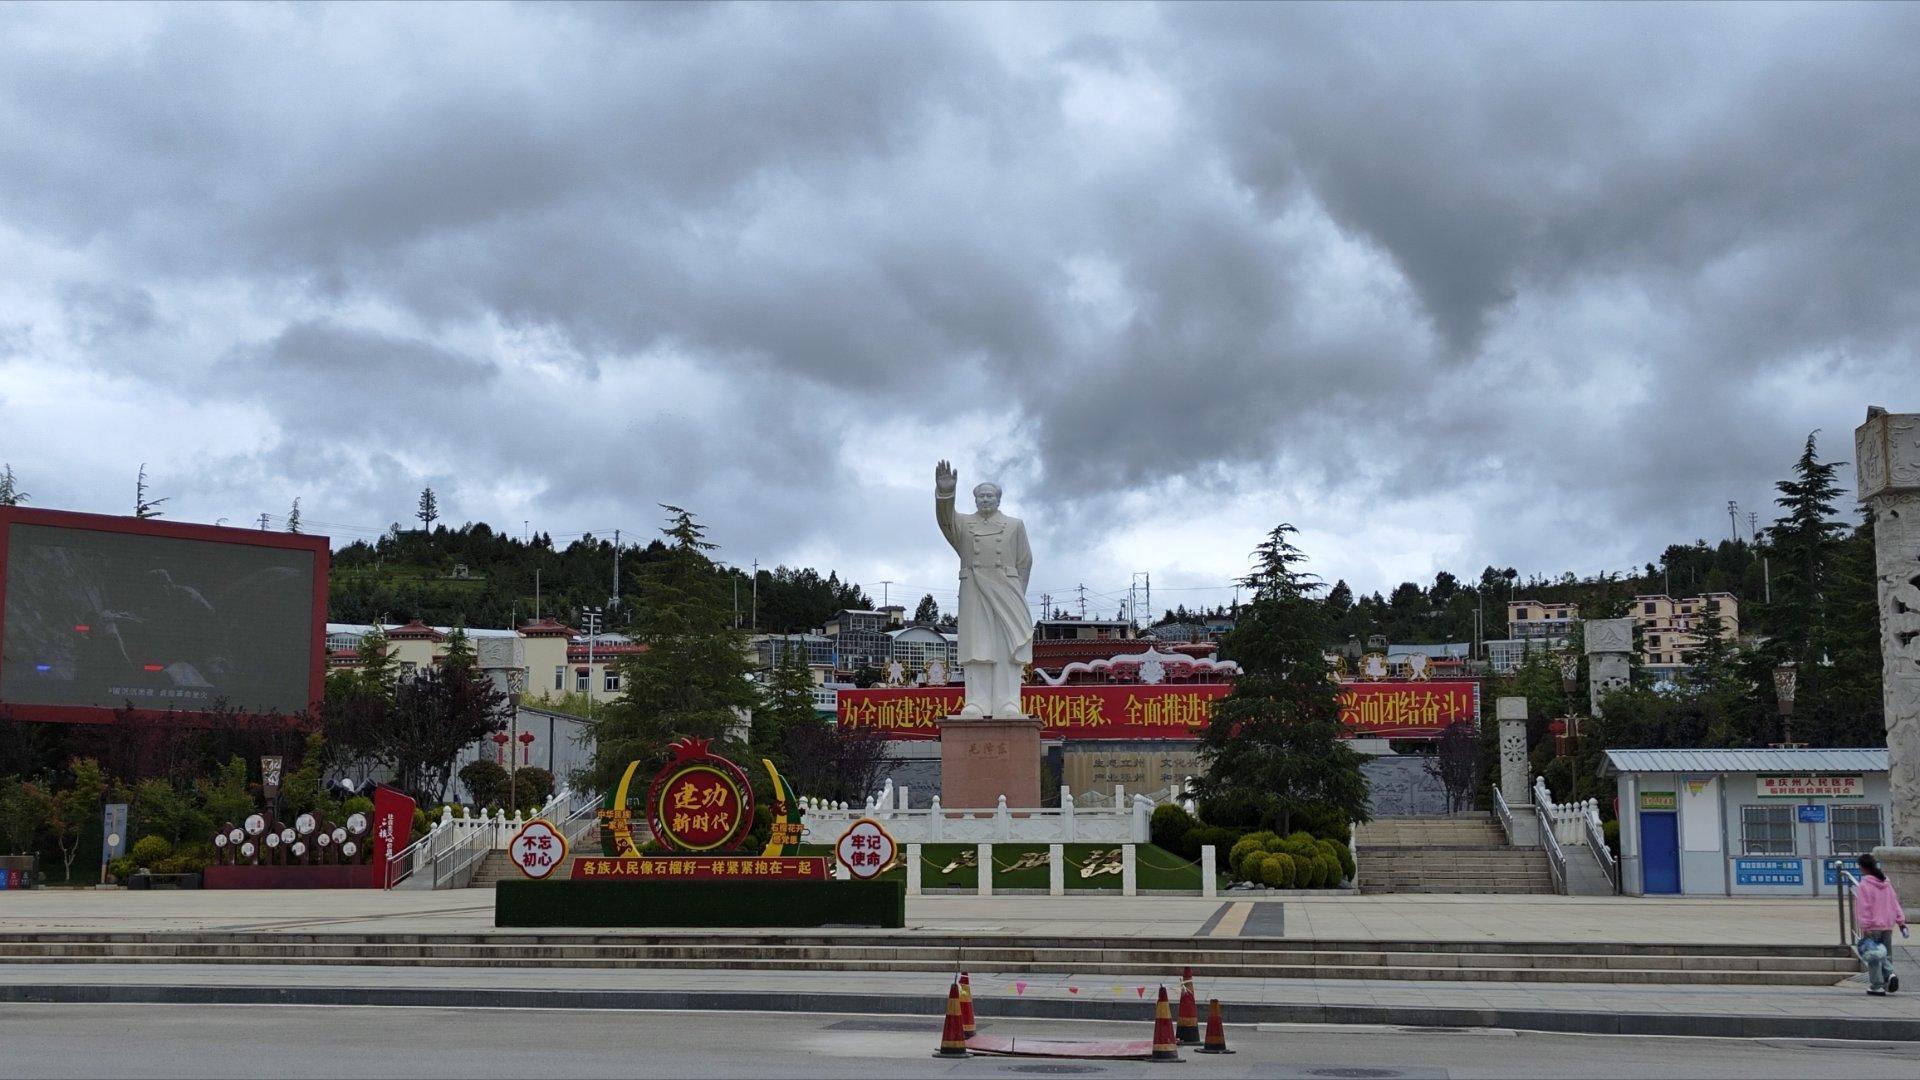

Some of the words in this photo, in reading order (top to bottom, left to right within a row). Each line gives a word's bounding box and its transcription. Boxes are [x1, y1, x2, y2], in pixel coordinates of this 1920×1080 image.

[1765, 778, 1855, 787] 迪庆州人民医院
[673, 781, 728, 810] 建功
[1770, 787, 1851, 795] 临时核酸检测采样点
[672, 811, 730, 834] 新时代
[522, 835, 552, 850] 不忘
[851, 834, 881, 850] 牢记
[522, 852, 553, 867] 初心
[851, 851, 881, 867] 使命
[583, 860, 812, 875] 各族人民像石榴籽一样紧紧抱在一起
